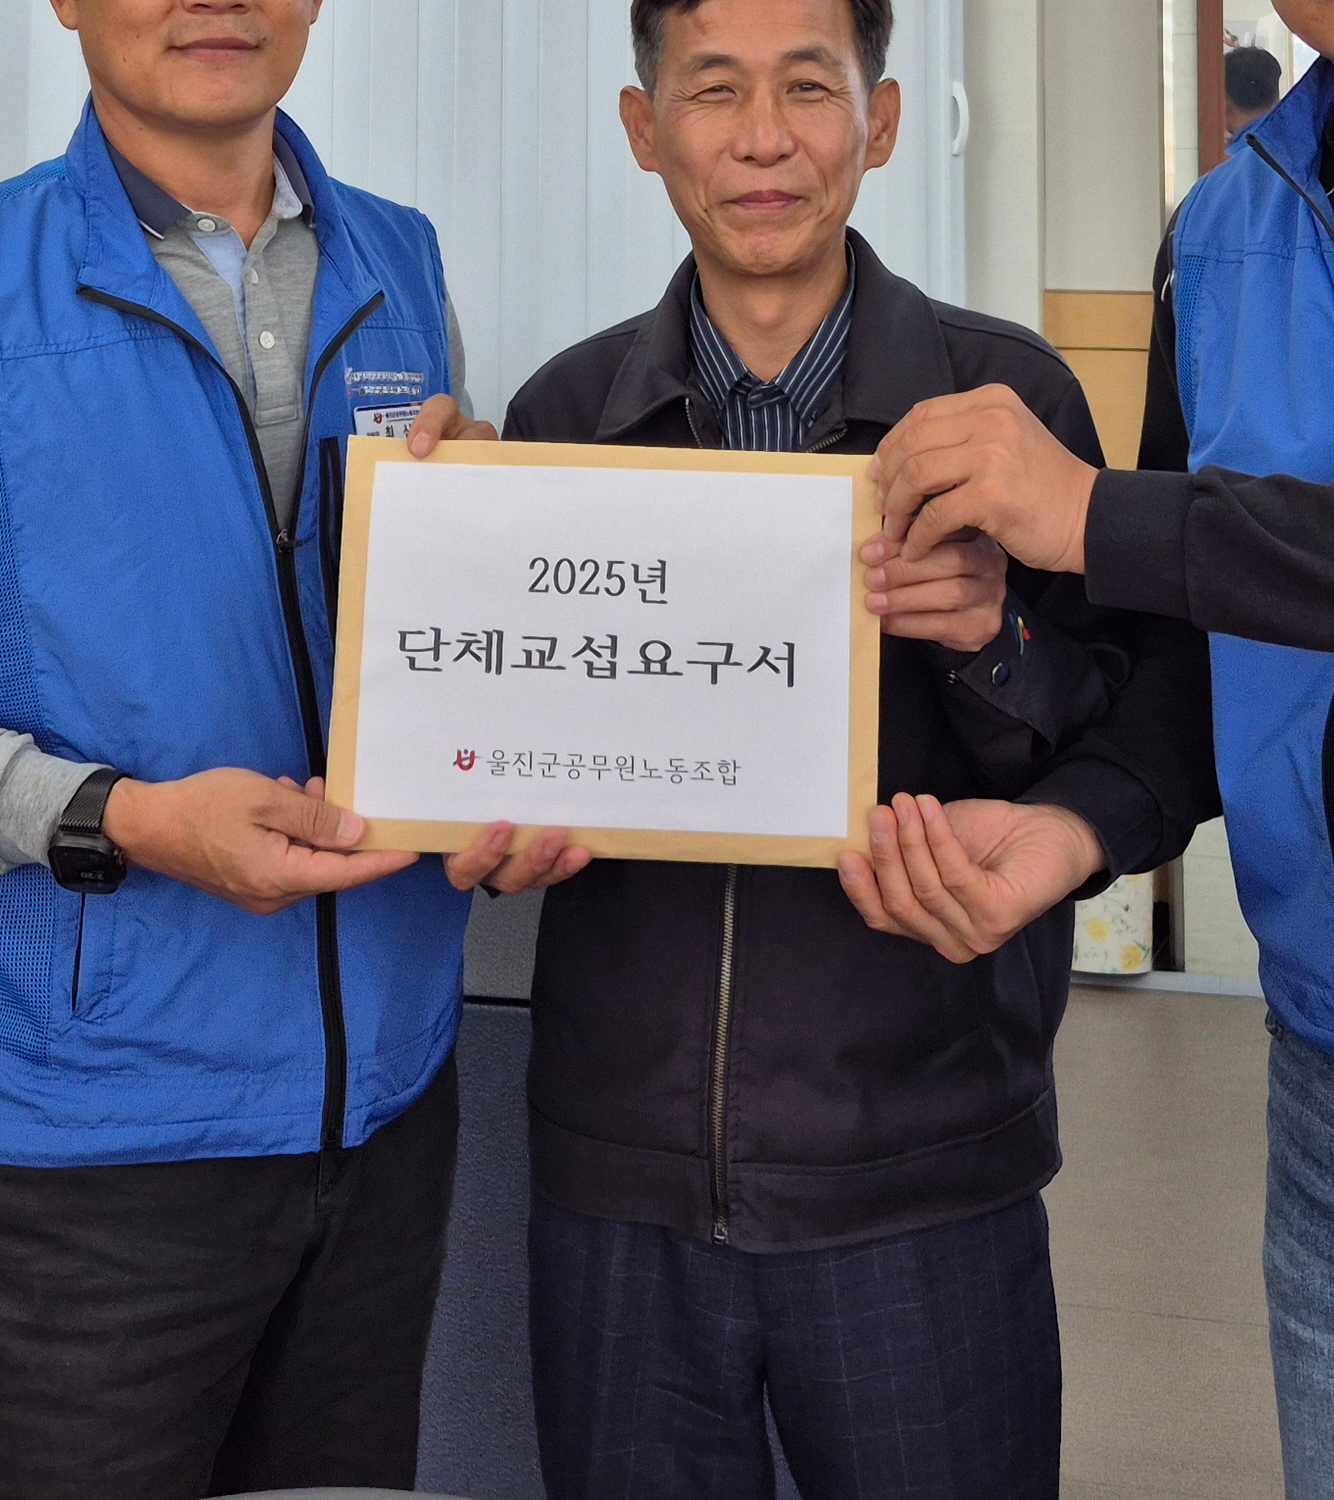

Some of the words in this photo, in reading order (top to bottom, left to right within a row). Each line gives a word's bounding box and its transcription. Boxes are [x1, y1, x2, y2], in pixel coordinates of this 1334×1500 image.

[527, 555, 668, 605] 2025년
[397, 626, 796, 688] 단체교섭요구서
[486, 749, 742, 787] 울진군공무원노동조합
